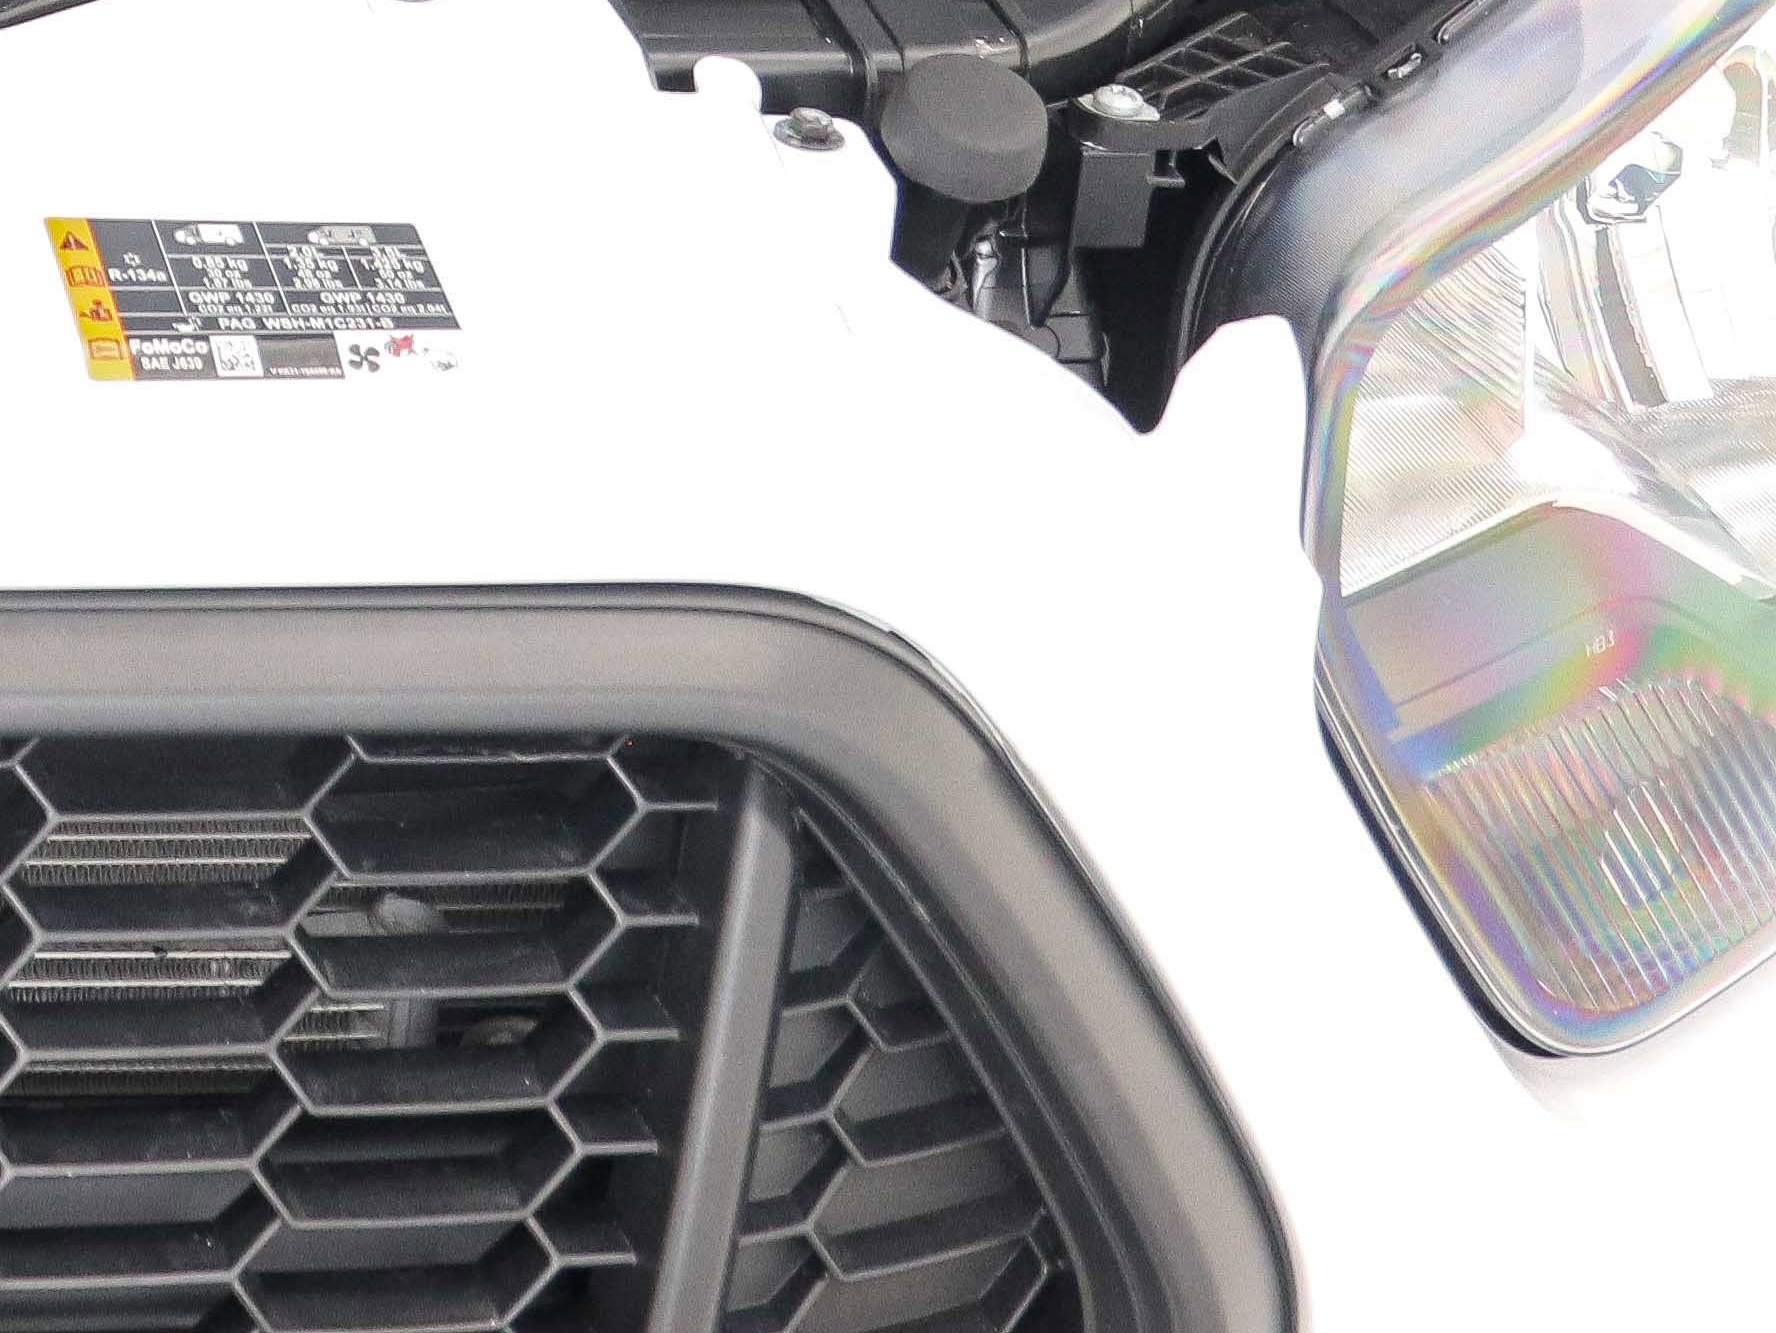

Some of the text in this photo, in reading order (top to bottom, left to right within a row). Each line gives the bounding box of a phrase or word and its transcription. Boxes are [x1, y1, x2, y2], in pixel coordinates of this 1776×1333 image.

[107, 267, 168, 283] R-134a
[188, 291, 275, 304] GWP 1430
[319, 291, 405, 304] GWP 1430
[128, 337, 209, 355] FoMoCo
